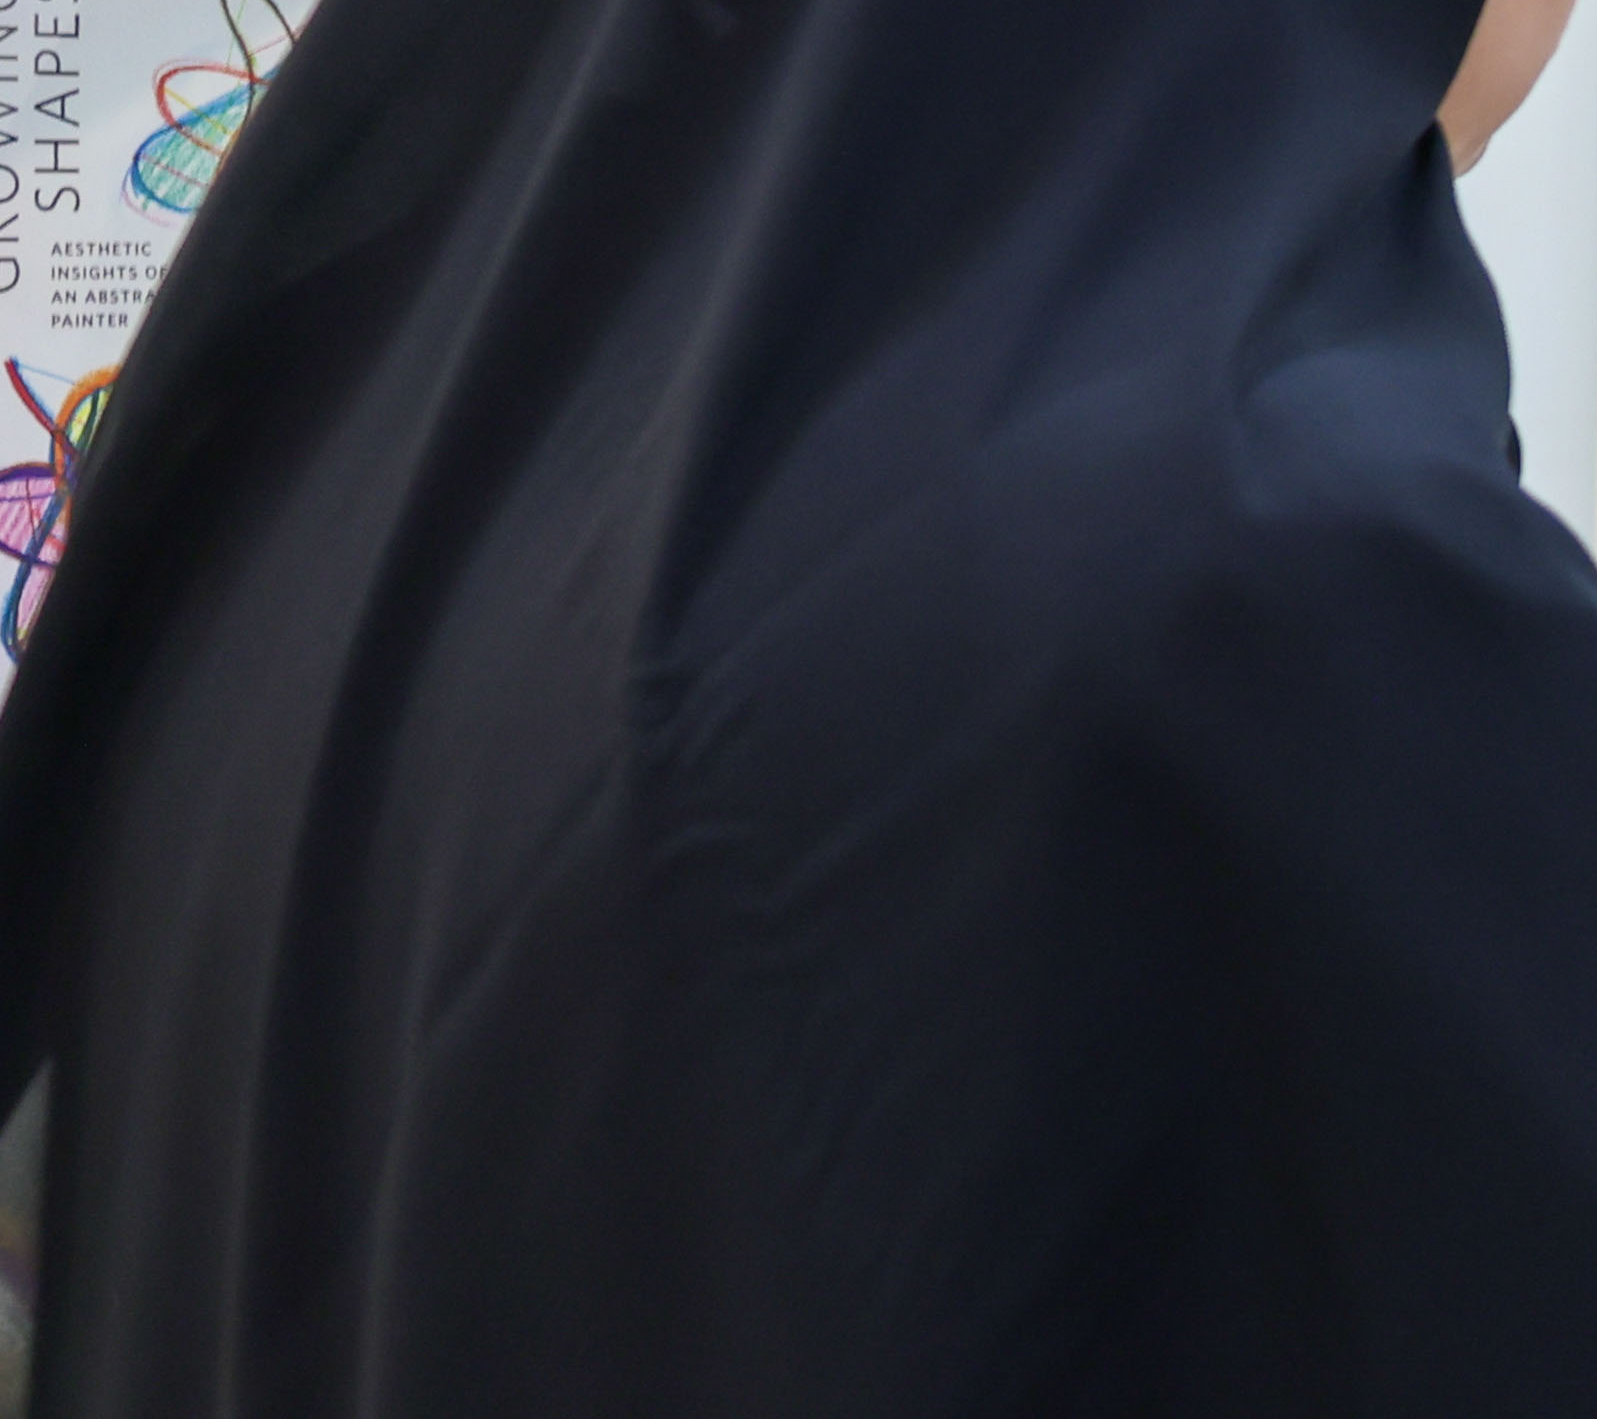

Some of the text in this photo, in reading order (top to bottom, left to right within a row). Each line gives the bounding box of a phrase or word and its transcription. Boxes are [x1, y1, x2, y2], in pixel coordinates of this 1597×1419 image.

[51, 243, 152, 257] AESTHETIC
[51, 266, 168, 280] INSIGHTS OF
[51, 291, 156, 304] AN ABSTRA
[51, 314, 129, 328] PAINTER
